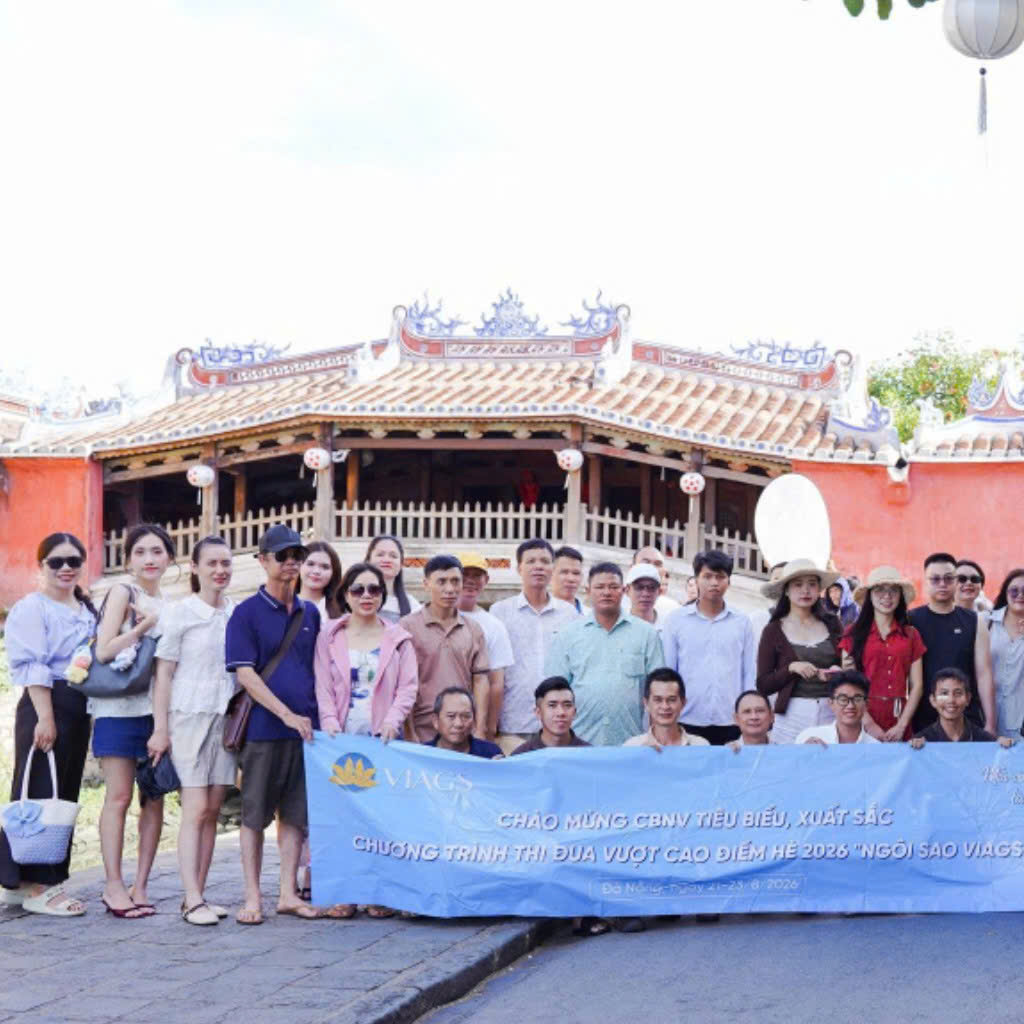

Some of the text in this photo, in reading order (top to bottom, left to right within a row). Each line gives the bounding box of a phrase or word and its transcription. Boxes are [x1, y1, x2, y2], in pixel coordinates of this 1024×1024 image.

[384, 767, 473, 792] VIAGS
[634, 812, 692, 829] CBNV
[696, 808, 738, 829] TIÊU
[798, 804, 850, 826] XUẤT
[853, 802, 895, 826] SẮC
[353, 835, 441, 862] CHƯƠNG
[514, 845, 548, 864] THI
[552, 846, 597, 864] ĐUA
[603, 844, 660, 868] VƯỢT
[663, 847, 711, 864] CAO
[716, 841, 767, 863] ĐIỂM
[801, 842, 849, 860] 2026
[918, 842, 958, 859] SAO
